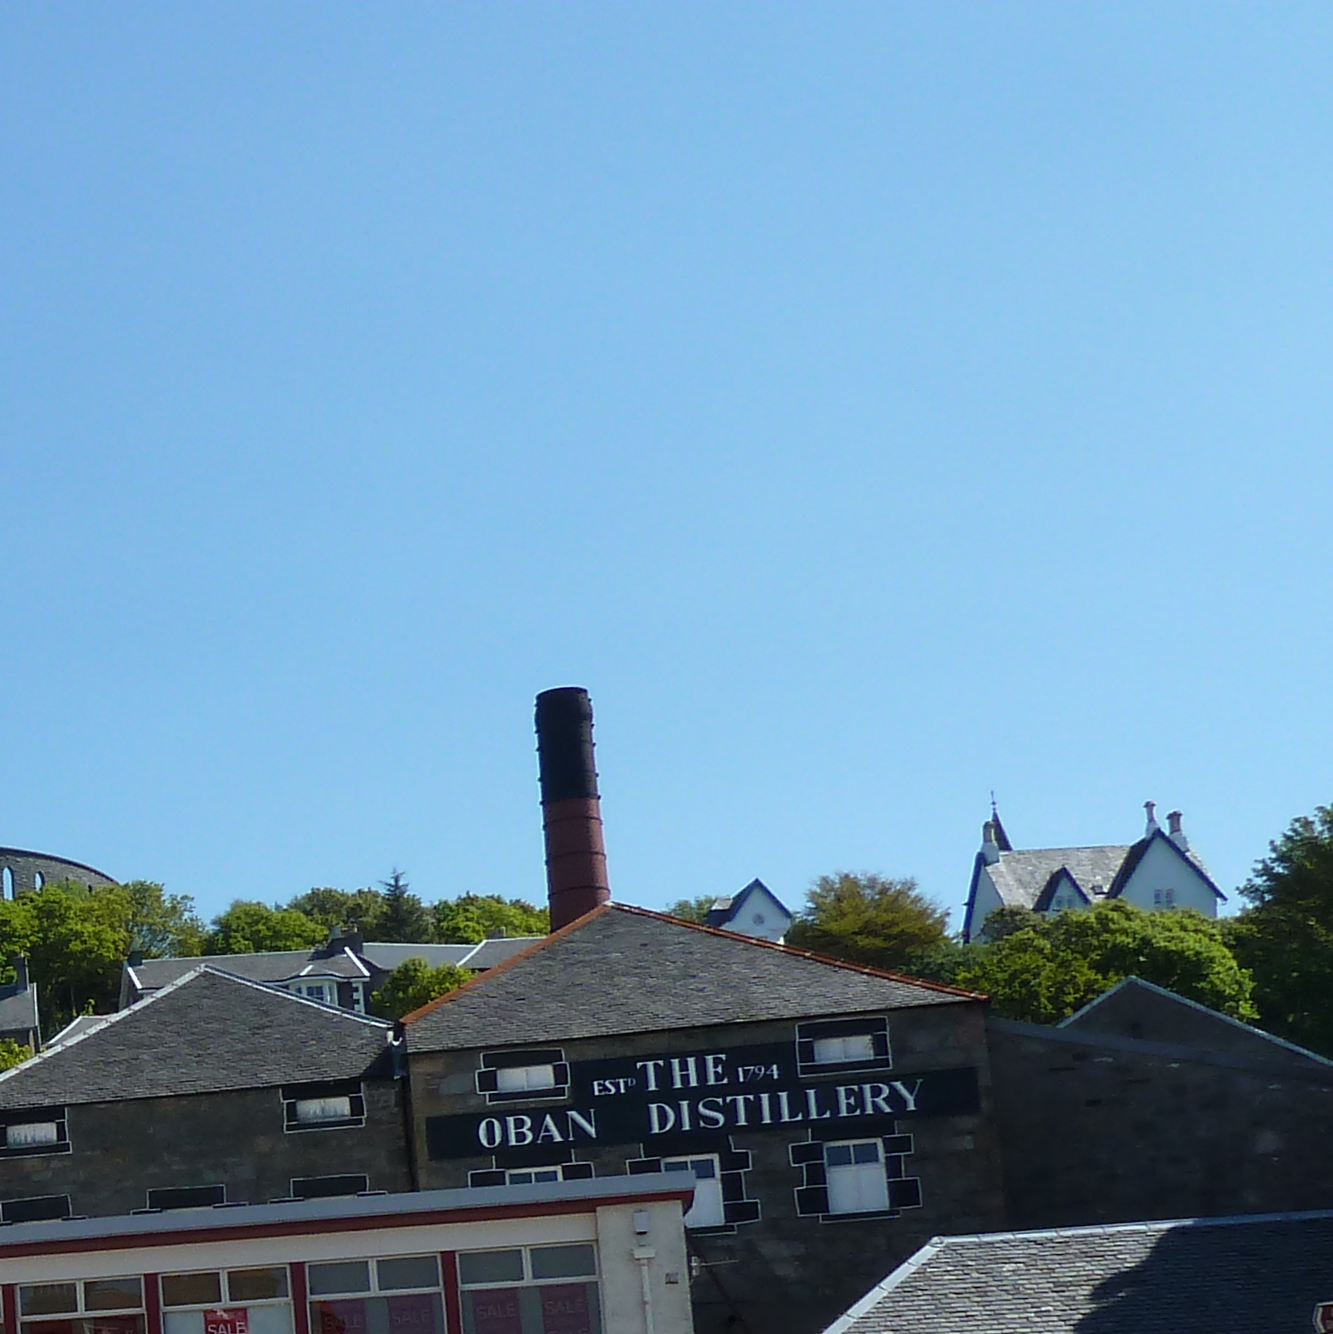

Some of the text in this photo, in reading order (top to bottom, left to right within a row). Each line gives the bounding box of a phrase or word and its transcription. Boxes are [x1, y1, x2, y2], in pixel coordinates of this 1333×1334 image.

[636, 1054, 730, 1092] THE
[737, 1063, 780, 1083] 1794
[477, 1078, 924, 1149] OBAN DISTILLERY
